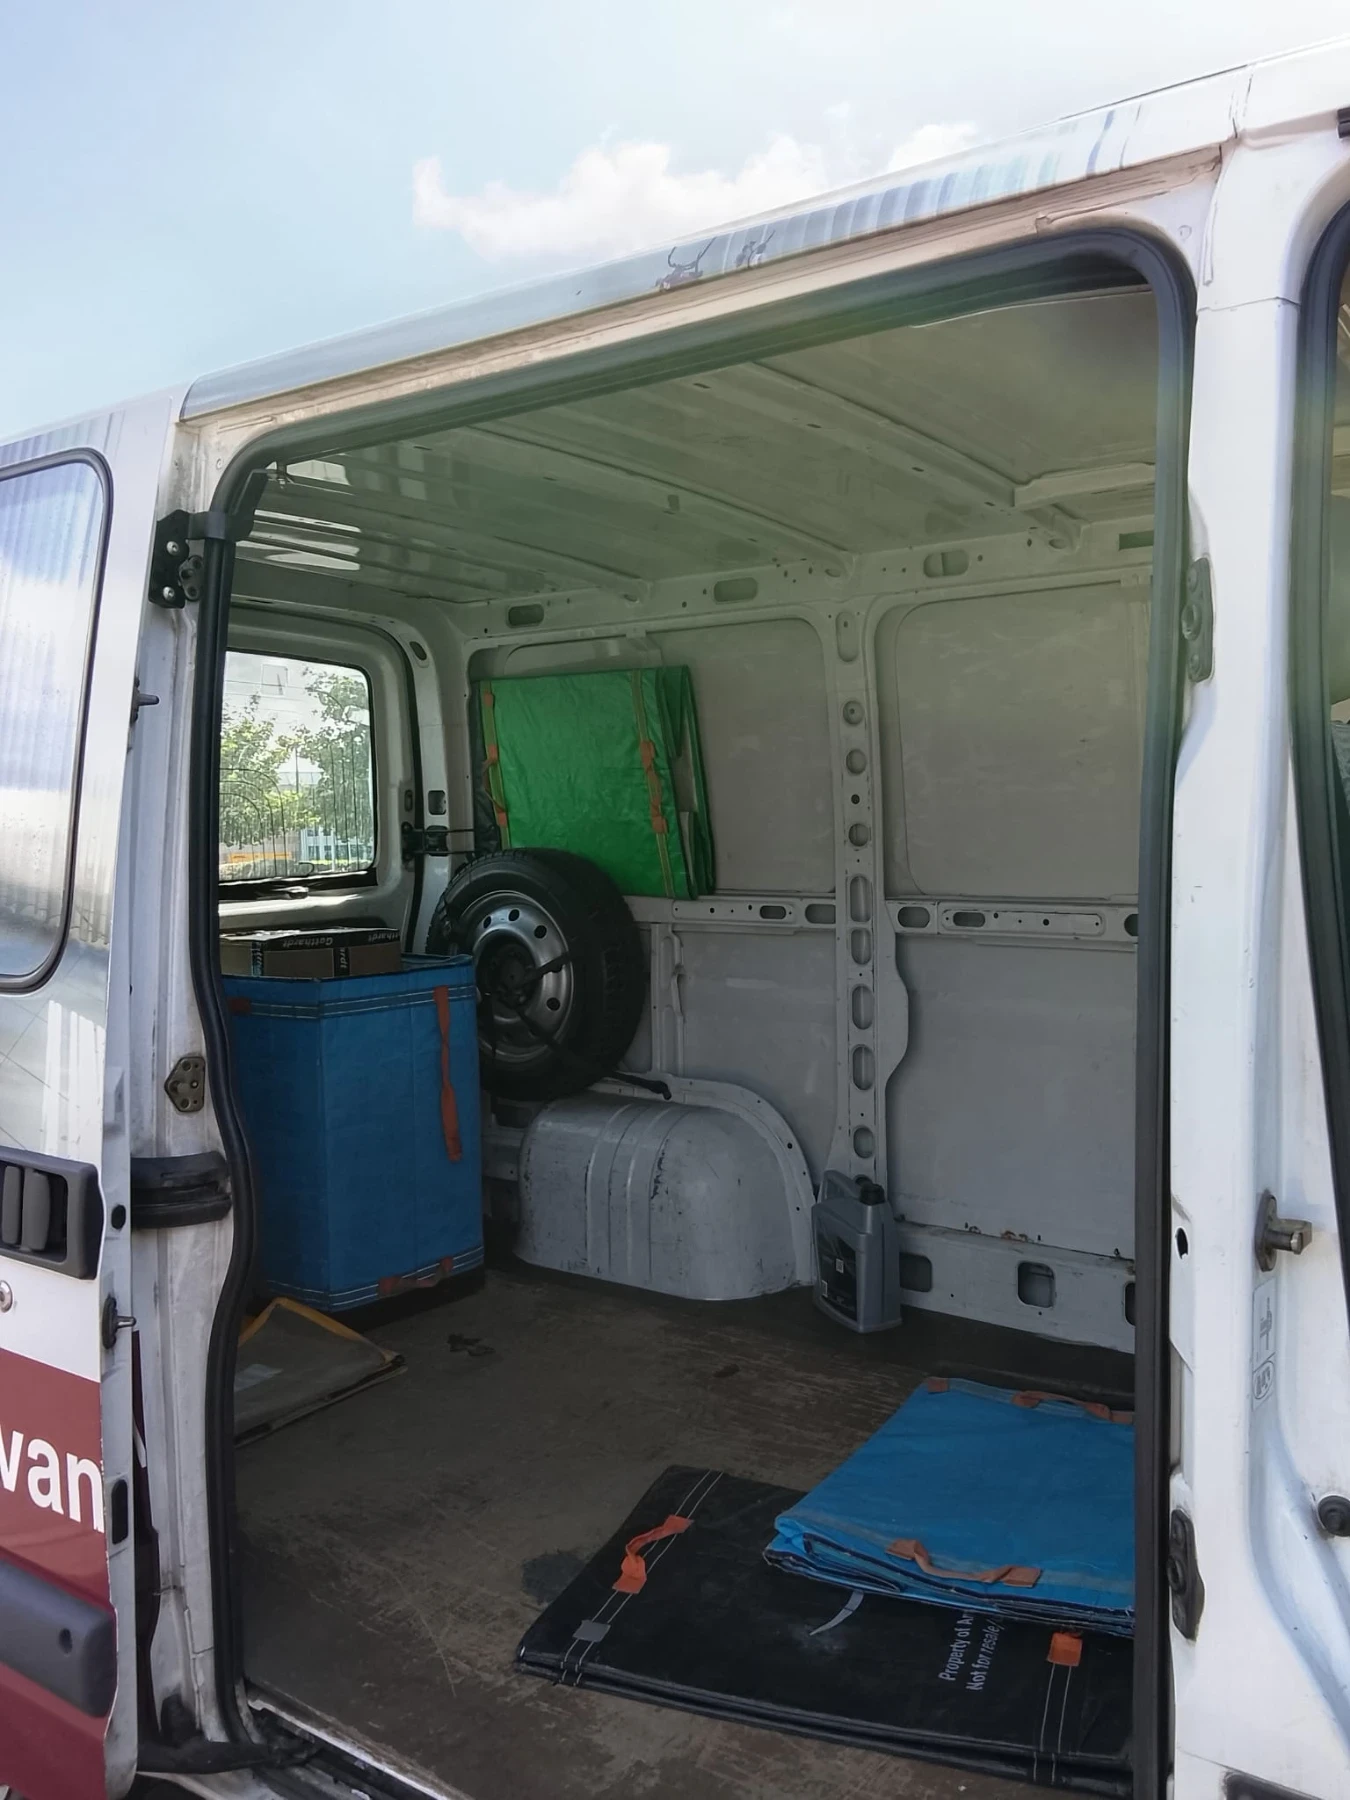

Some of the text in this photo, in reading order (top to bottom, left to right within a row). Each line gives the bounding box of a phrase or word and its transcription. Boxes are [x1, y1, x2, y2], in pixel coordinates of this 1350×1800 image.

[954, 1627, 971, 1638] of
[938, 1639, 971, 1681] Property
[971, 1653, 992, 1669] for
[965, 1670, 988, 1690] Not
